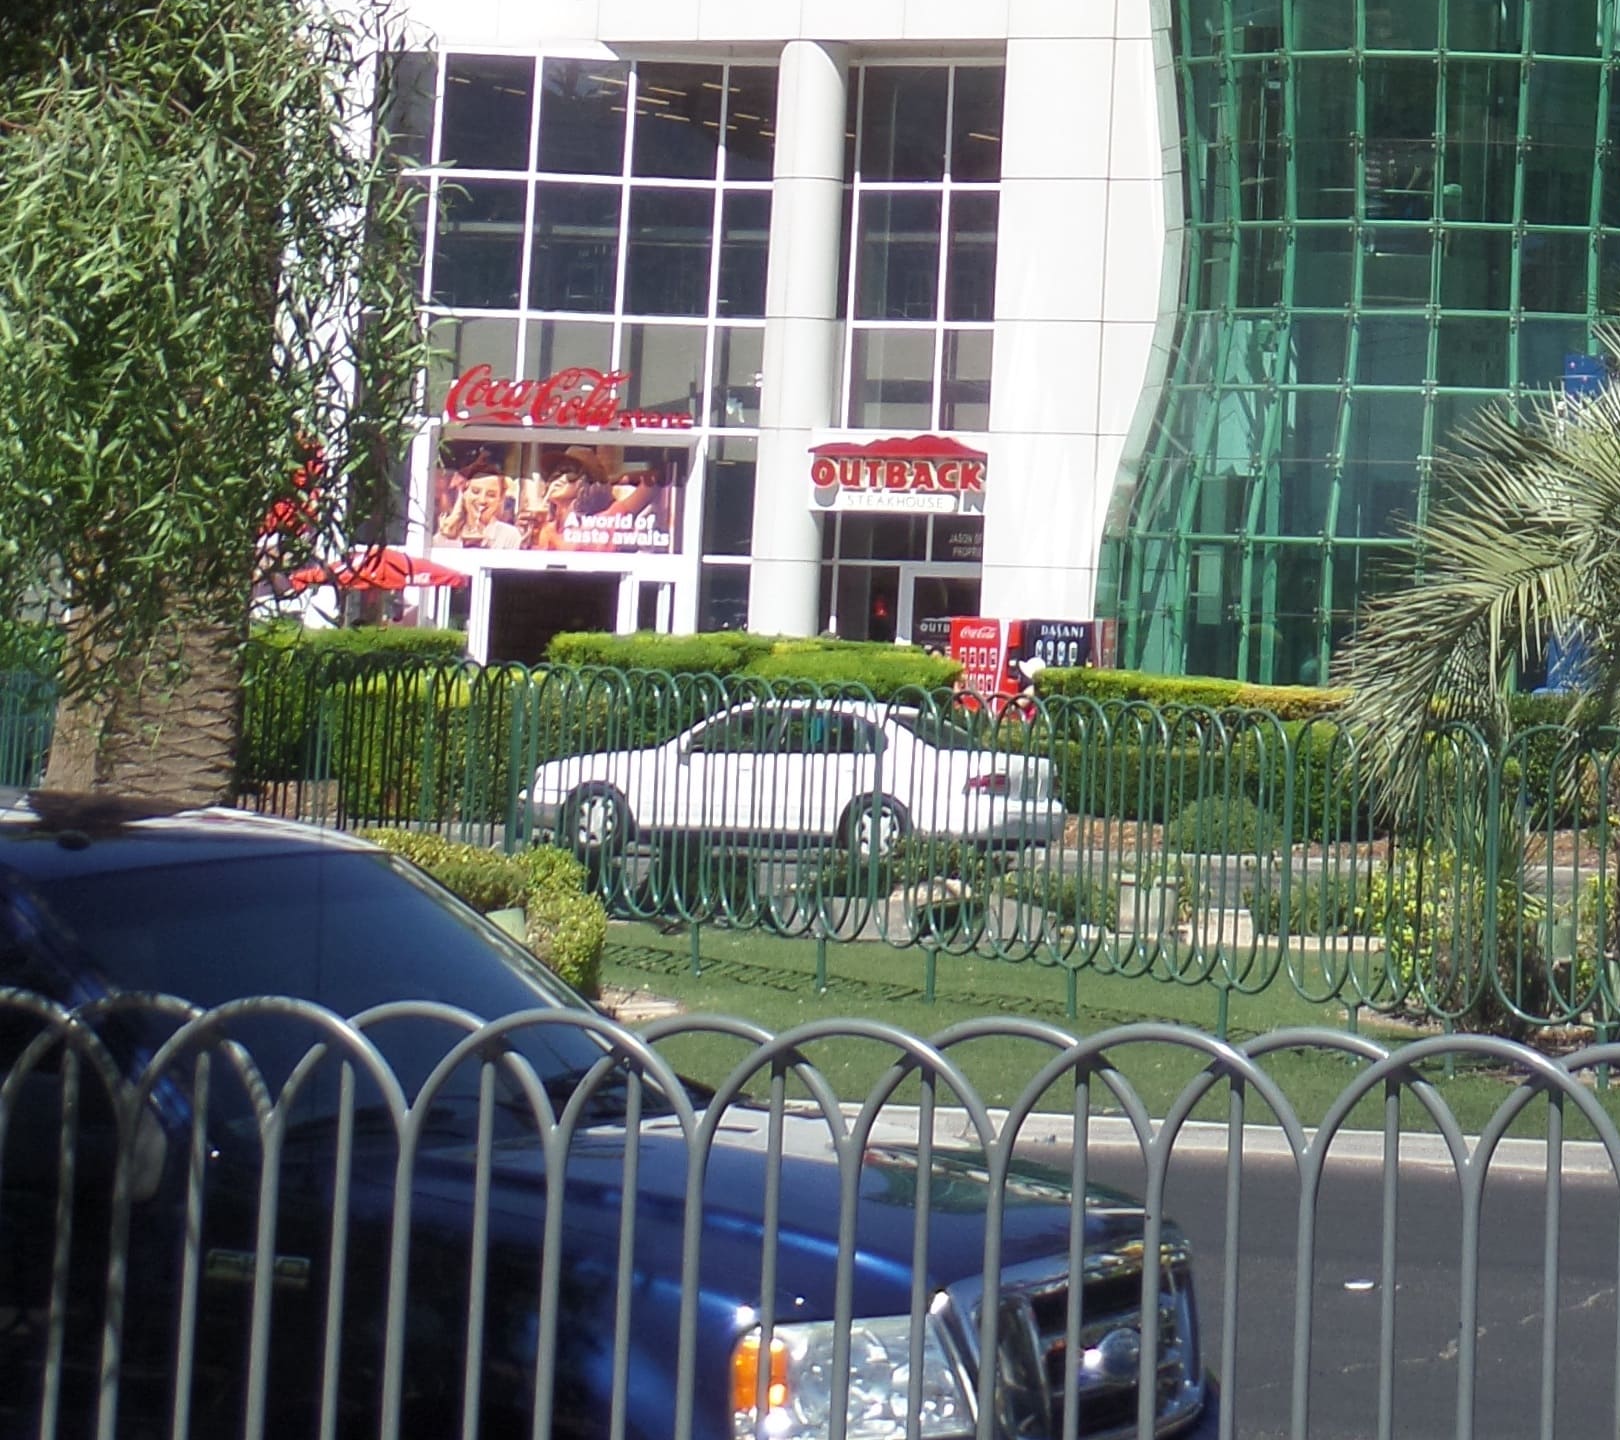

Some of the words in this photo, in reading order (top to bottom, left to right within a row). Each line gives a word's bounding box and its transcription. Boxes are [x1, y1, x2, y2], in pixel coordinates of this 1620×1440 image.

[811, 457, 984, 492] OUTBACK
[847, 494, 943, 508] STEAKHOUSE
[563, 511, 581, 527] A
[581, 512, 633, 529] world
[635, 513, 656, 530] of
[563, 528, 609, 545] taste
[612, 528, 670, 547] awaits
[1040, 623, 1084, 639] DASANI
